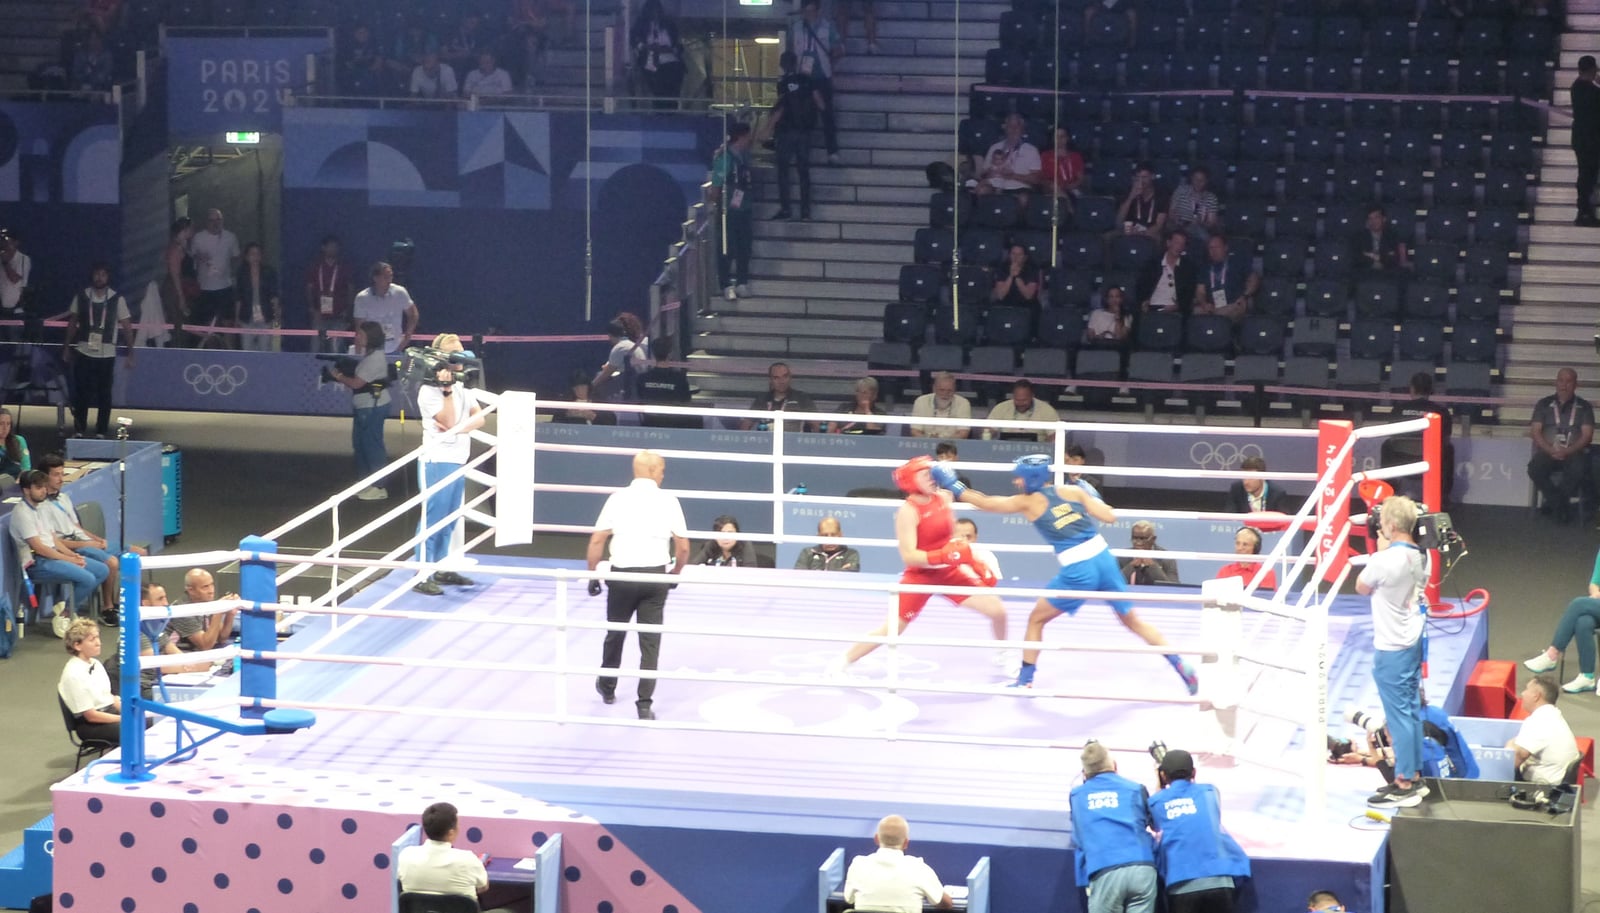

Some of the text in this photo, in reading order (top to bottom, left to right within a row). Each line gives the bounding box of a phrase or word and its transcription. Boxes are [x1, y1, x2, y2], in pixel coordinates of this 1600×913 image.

[1457, 461, 1512, 481] 024
[792, 507, 857, 519] PARIS 2024
[1318, 684, 1326, 724] PARIS
[1476, 750, 1512, 761] 2024
